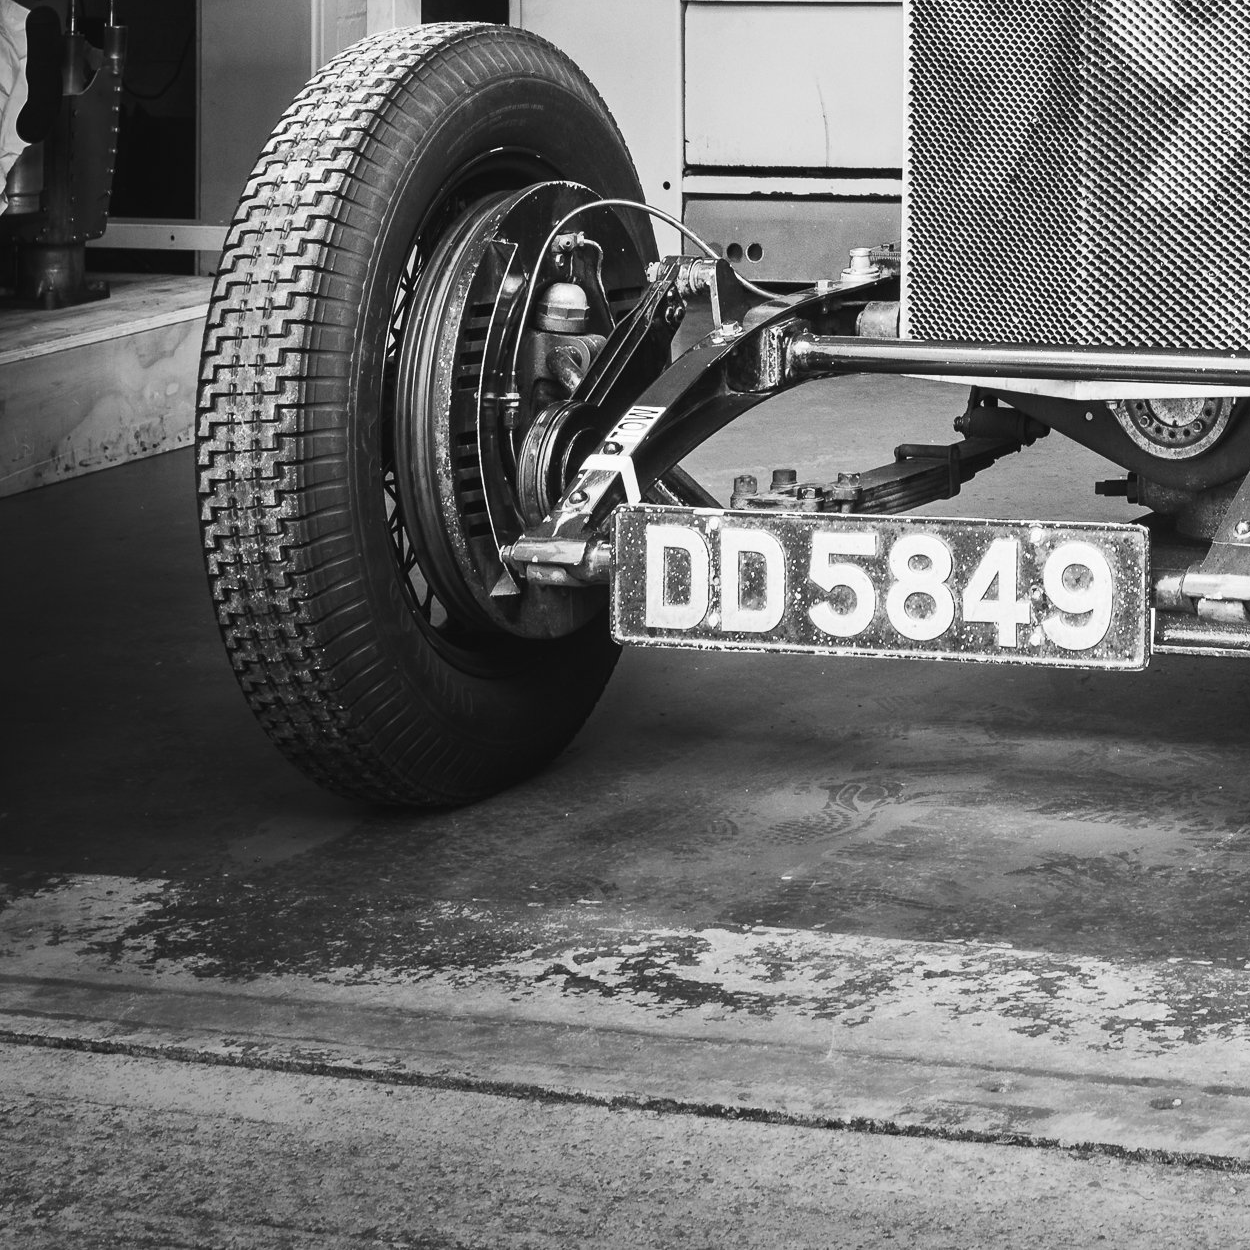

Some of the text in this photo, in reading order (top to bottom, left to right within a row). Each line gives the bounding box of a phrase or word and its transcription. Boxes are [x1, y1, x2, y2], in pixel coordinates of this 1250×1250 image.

[609, 408, 659, 438] TOW
[645, 525, 1113, 652] DD 5849
